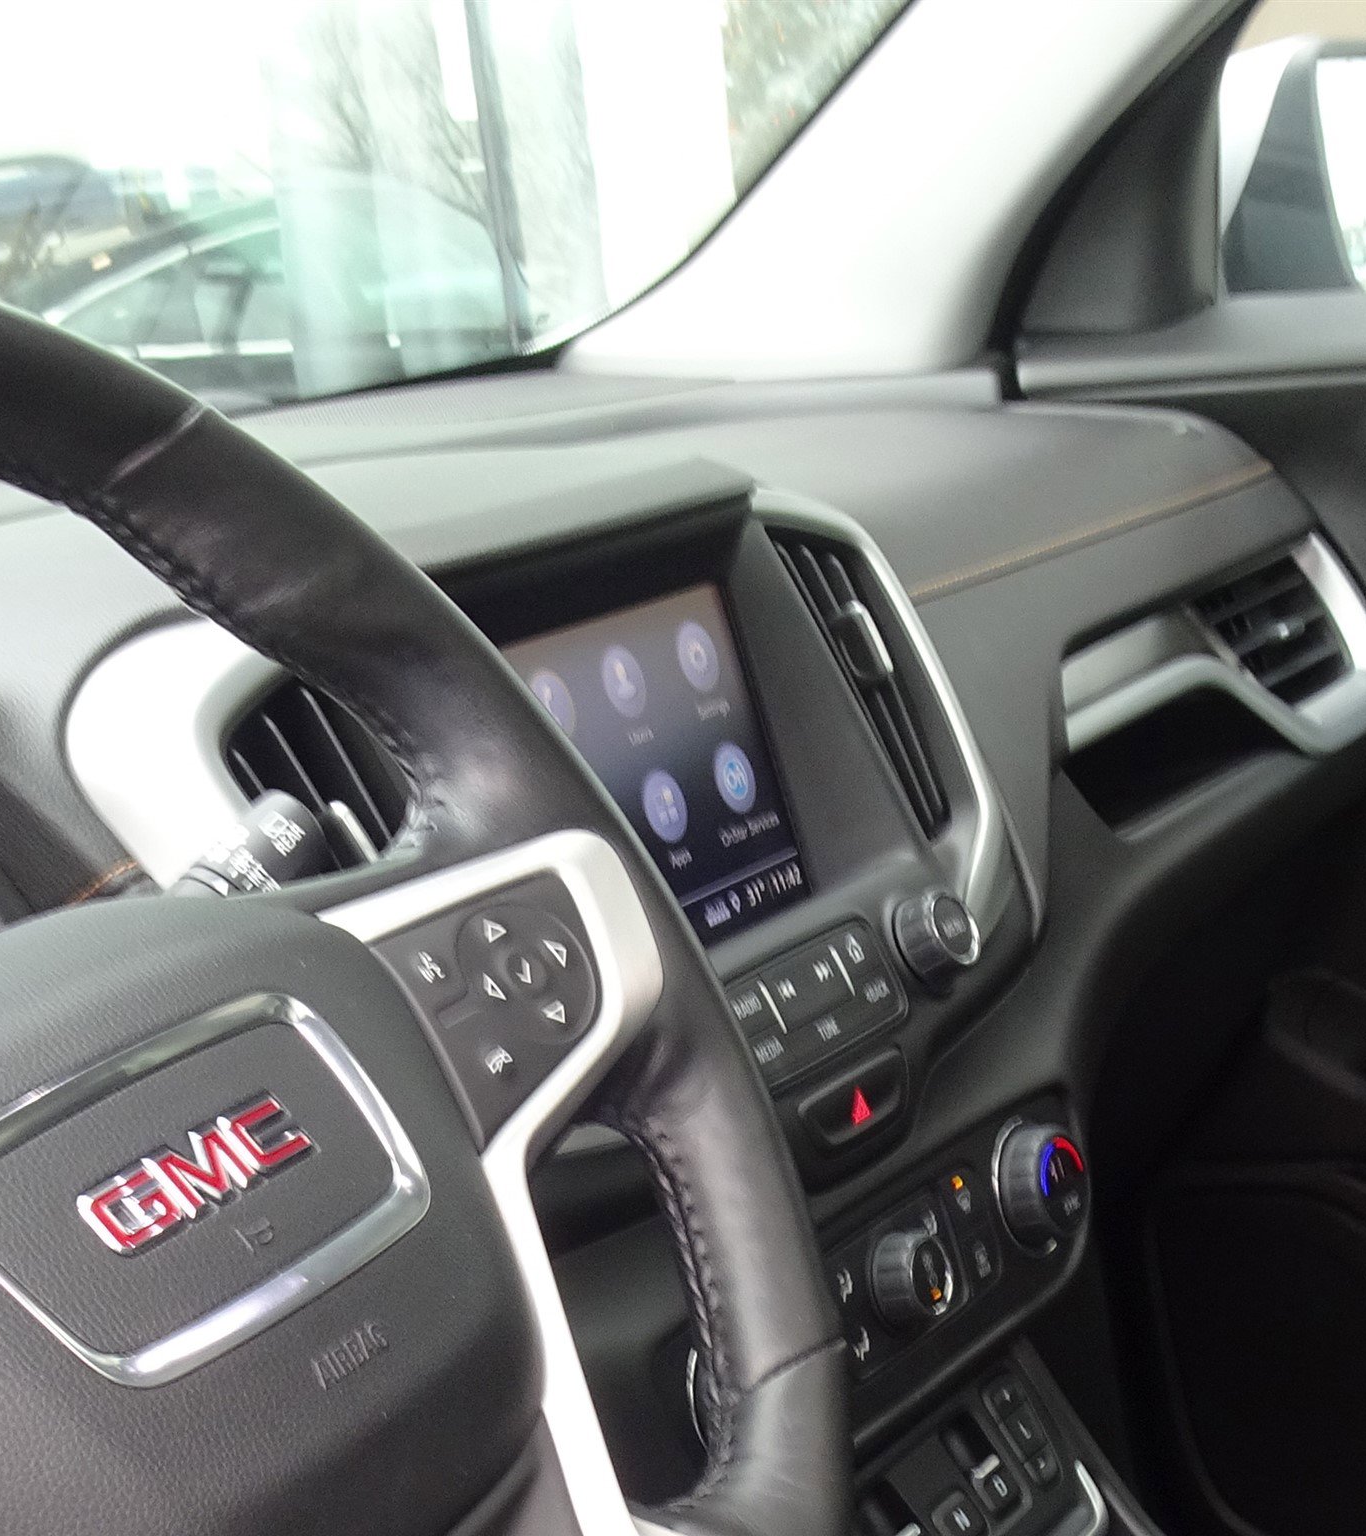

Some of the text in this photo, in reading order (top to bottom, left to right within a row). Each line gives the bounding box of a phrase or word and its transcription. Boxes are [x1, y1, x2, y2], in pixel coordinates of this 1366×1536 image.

[669, 848, 693, 870] Apps
[732, 989, 763, 1021] RADIO
[752, 1035, 785, 1065] MEDIA
[76, 1089, 321, 1258] GMC
[310, 1319, 389, 1391] AIRBAG
[990, 1473, 1009, 1498] D
[951, 1506, 971, 1532] N
